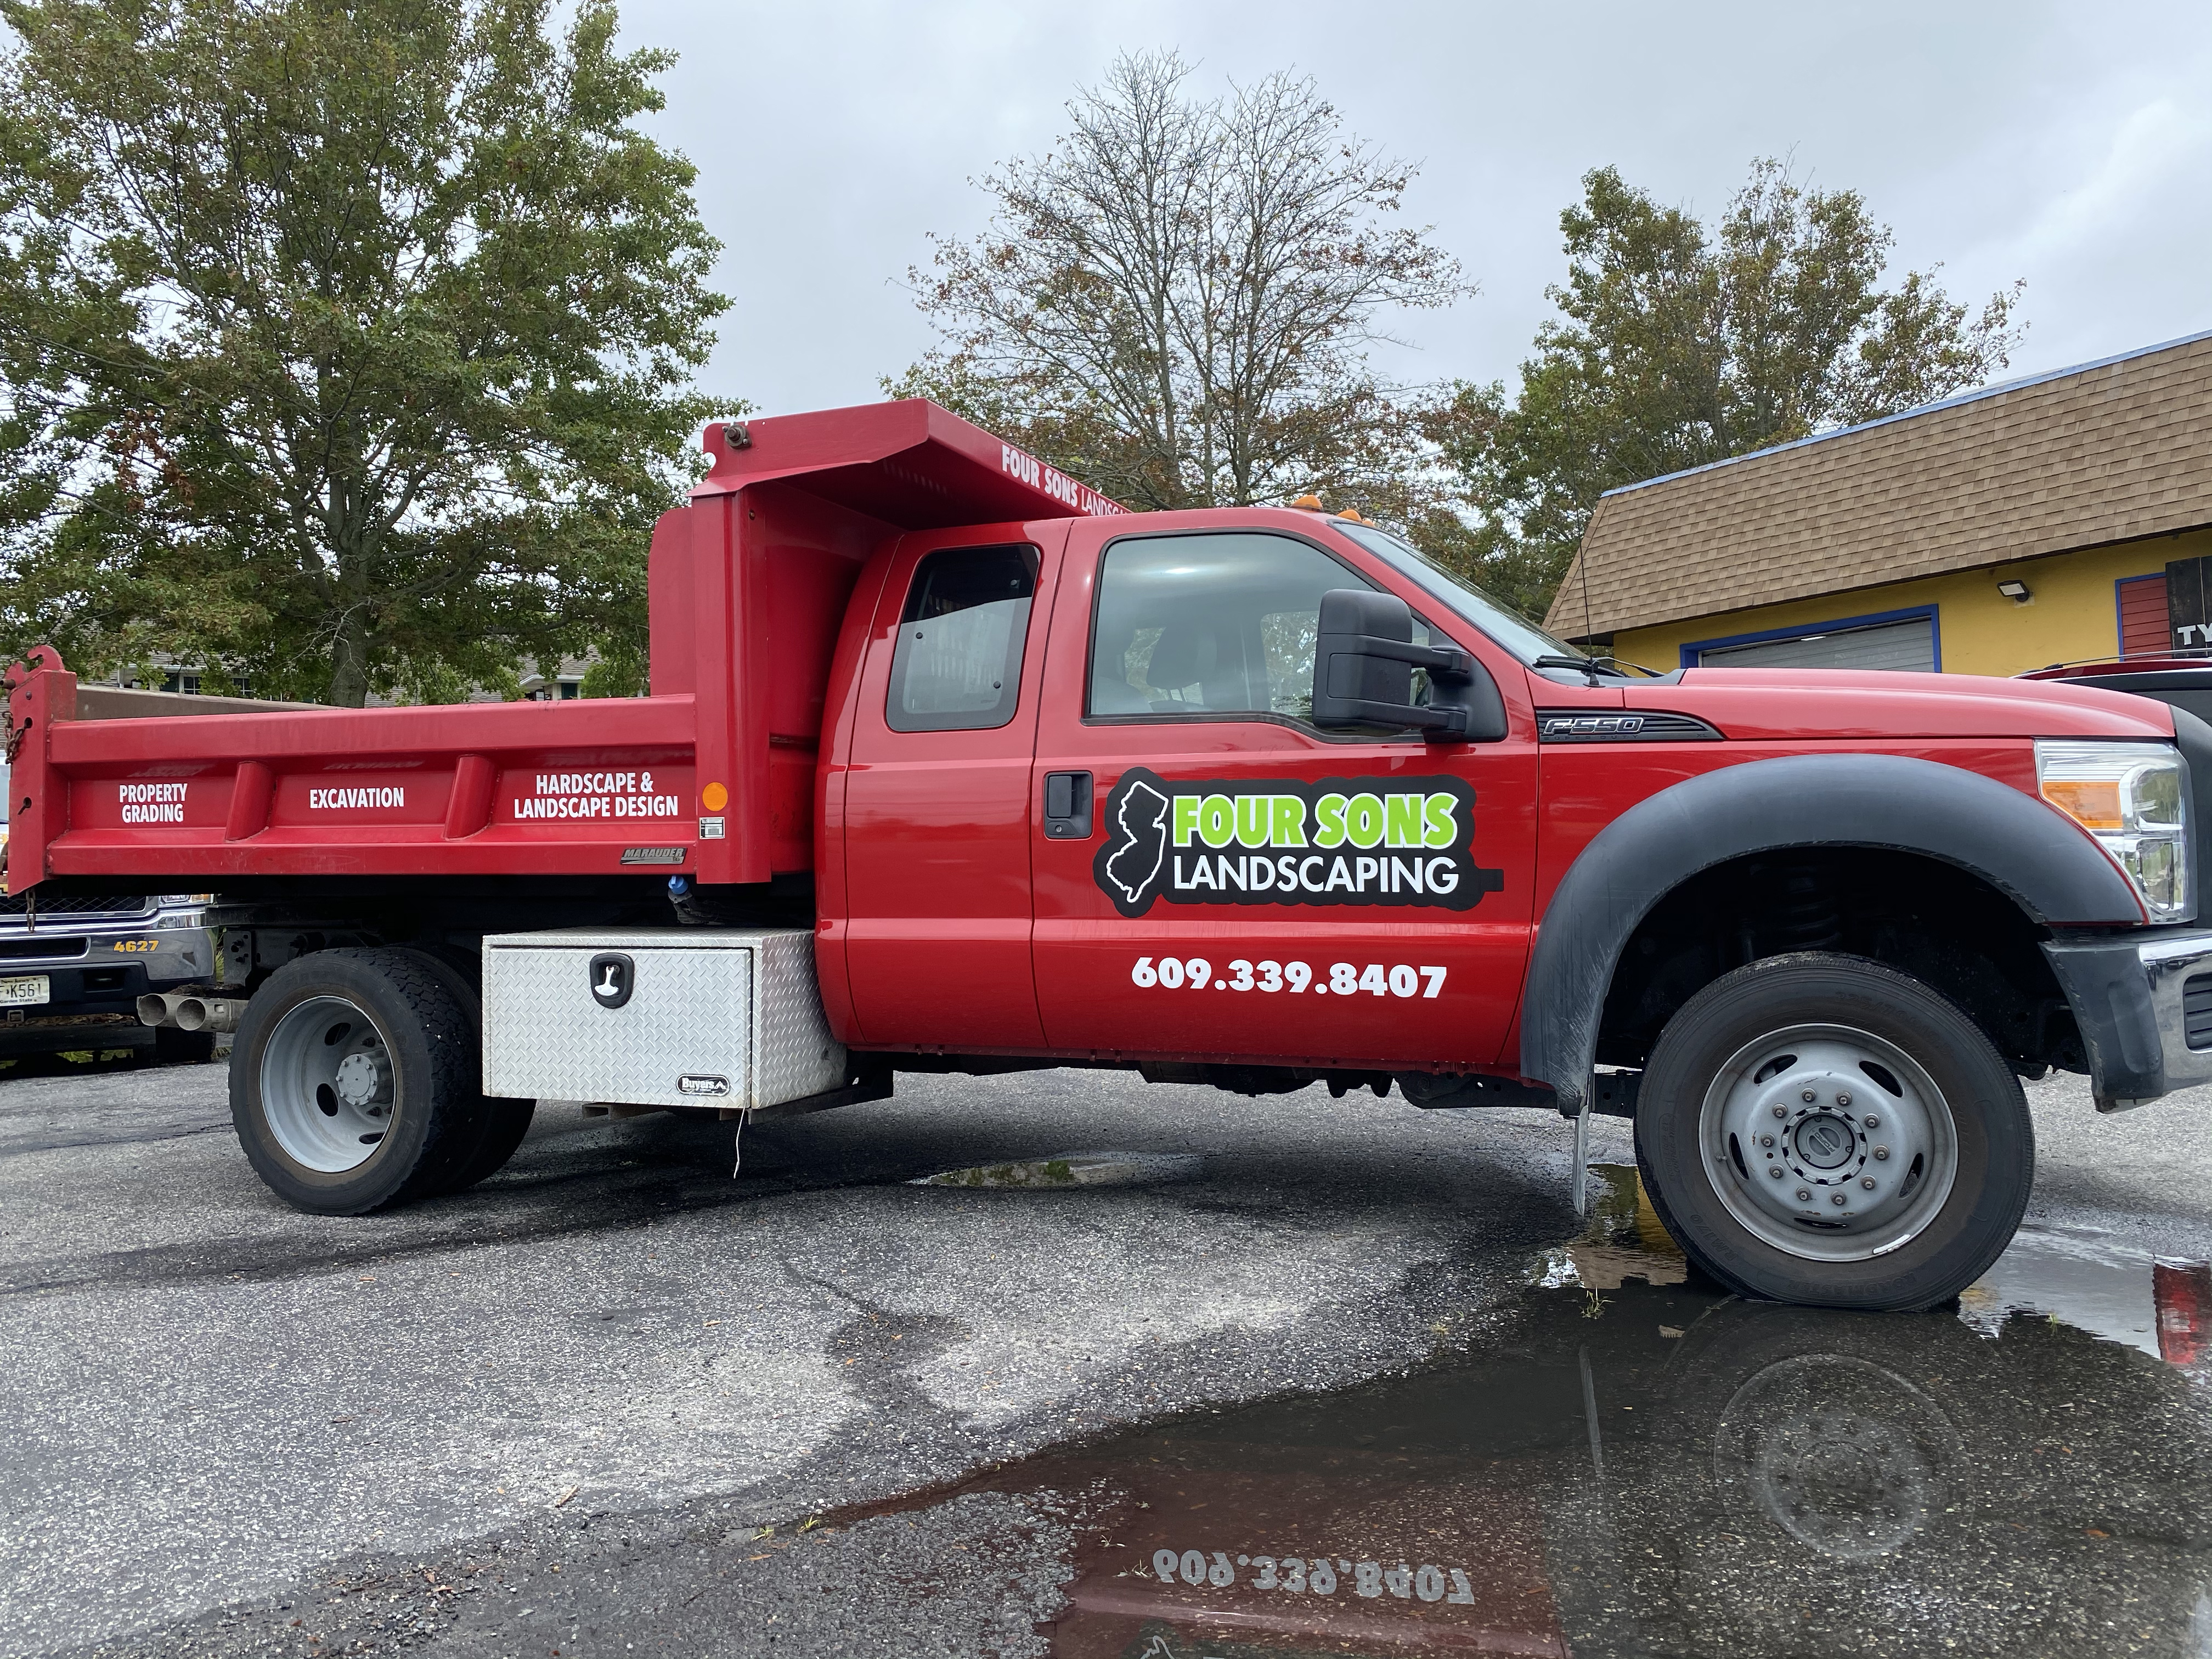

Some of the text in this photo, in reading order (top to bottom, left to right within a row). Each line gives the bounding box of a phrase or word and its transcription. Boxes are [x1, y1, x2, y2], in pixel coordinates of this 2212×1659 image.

[1002, 444, 1040, 489] FOUR
[1044, 468, 1078, 507] SONS
[2177, 622, 2212, 645] TY
[1543, 717, 1644, 736] F-550
[119, 783, 188, 803] PROPERTY
[536, 771, 654, 794] HARDSCAPE &
[310, 787, 404, 809] EXCAVATION
[514, 795, 678, 819] LANDSCAPE DESIGN
[122, 803, 184, 823] GRADING
[1172, 792, 1459, 850] FOUR SONS
[624, 848, 684, 857] MARAUDER
[1173, 855, 1459, 894] LANDSCAPING
[114, 940, 160, 953] 4627
[1131, 957, 1447, 998] 609.339.8407
[682, 1077, 715, 1091] Buyers
[1814, 1132, 1836, 1153] FORD
[1690, 1214, 1739, 1261] RM170
